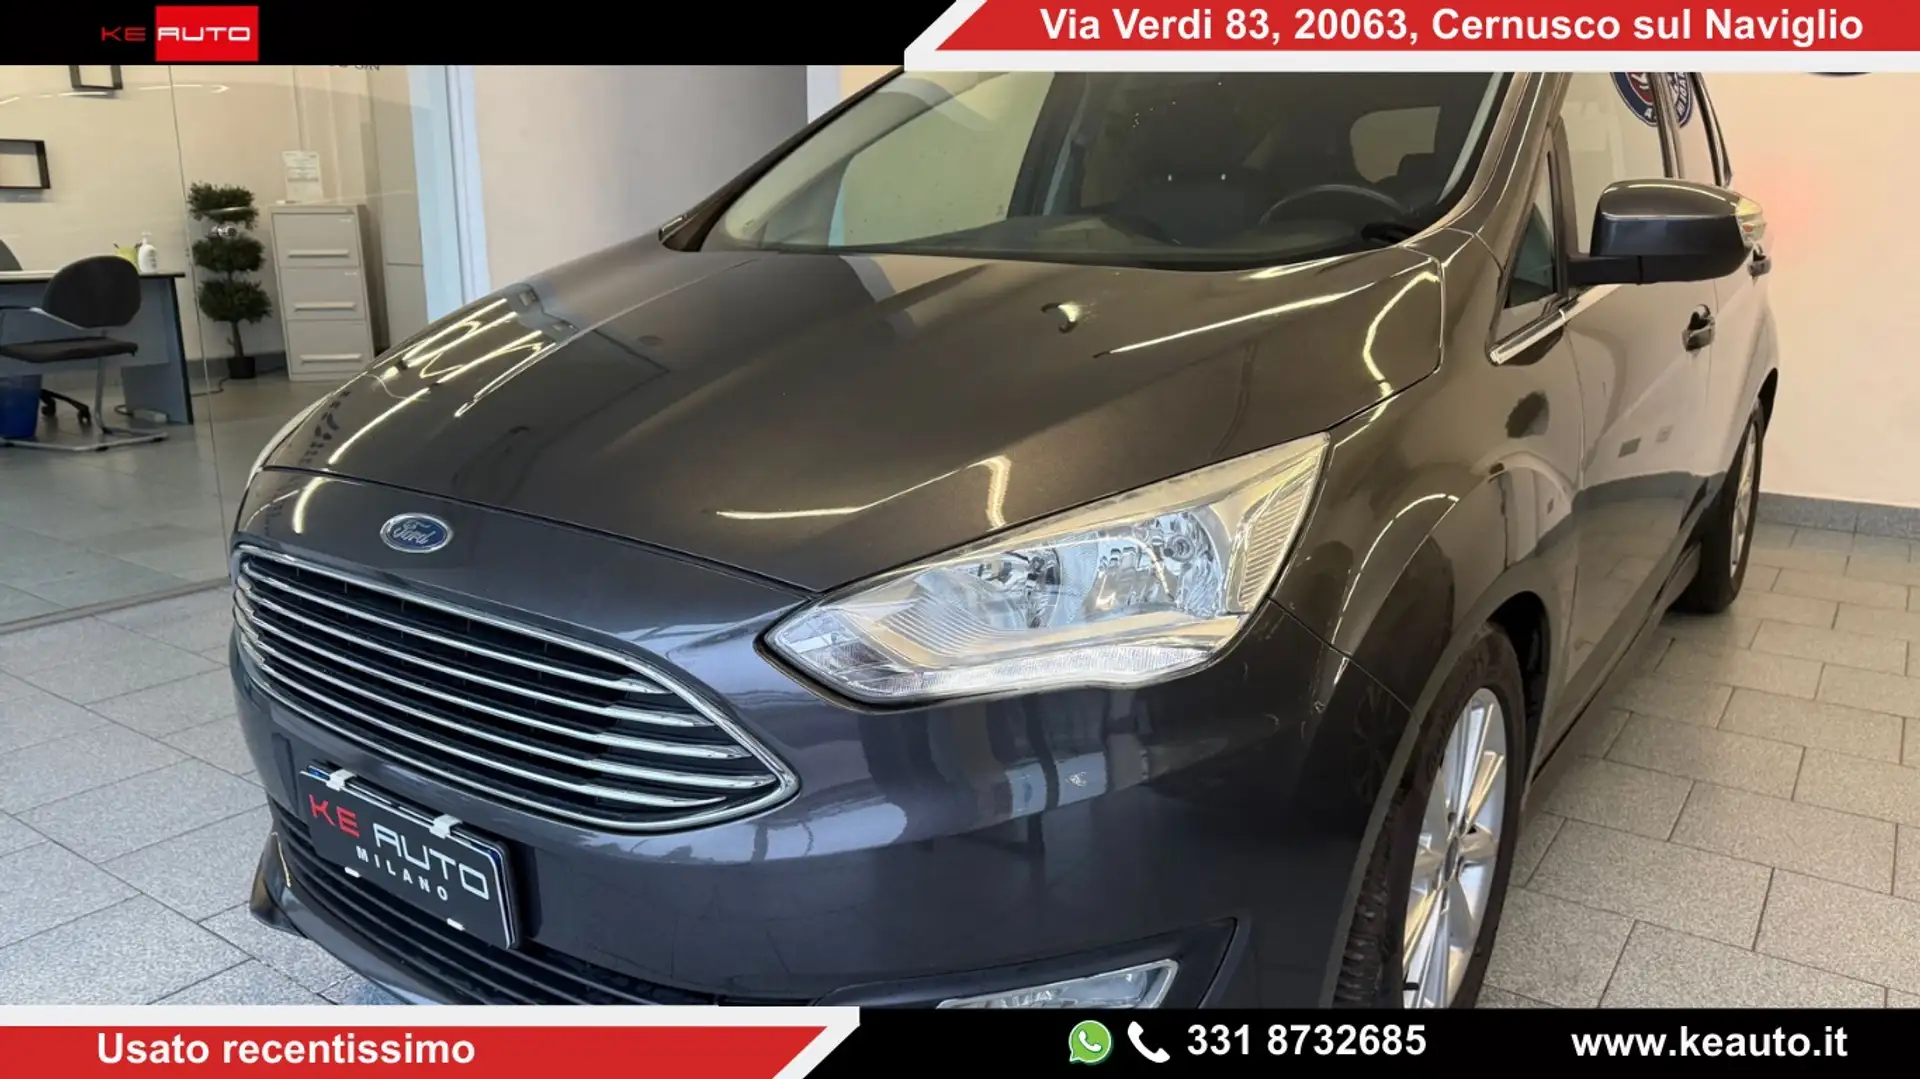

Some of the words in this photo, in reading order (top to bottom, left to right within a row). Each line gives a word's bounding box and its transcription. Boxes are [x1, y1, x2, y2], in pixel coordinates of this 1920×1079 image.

[392, 518, 438, 546] Ford
[308, 793, 361, 839] KE
[372, 822, 490, 901] AUTO
[355, 845, 449, 901] MILANO
